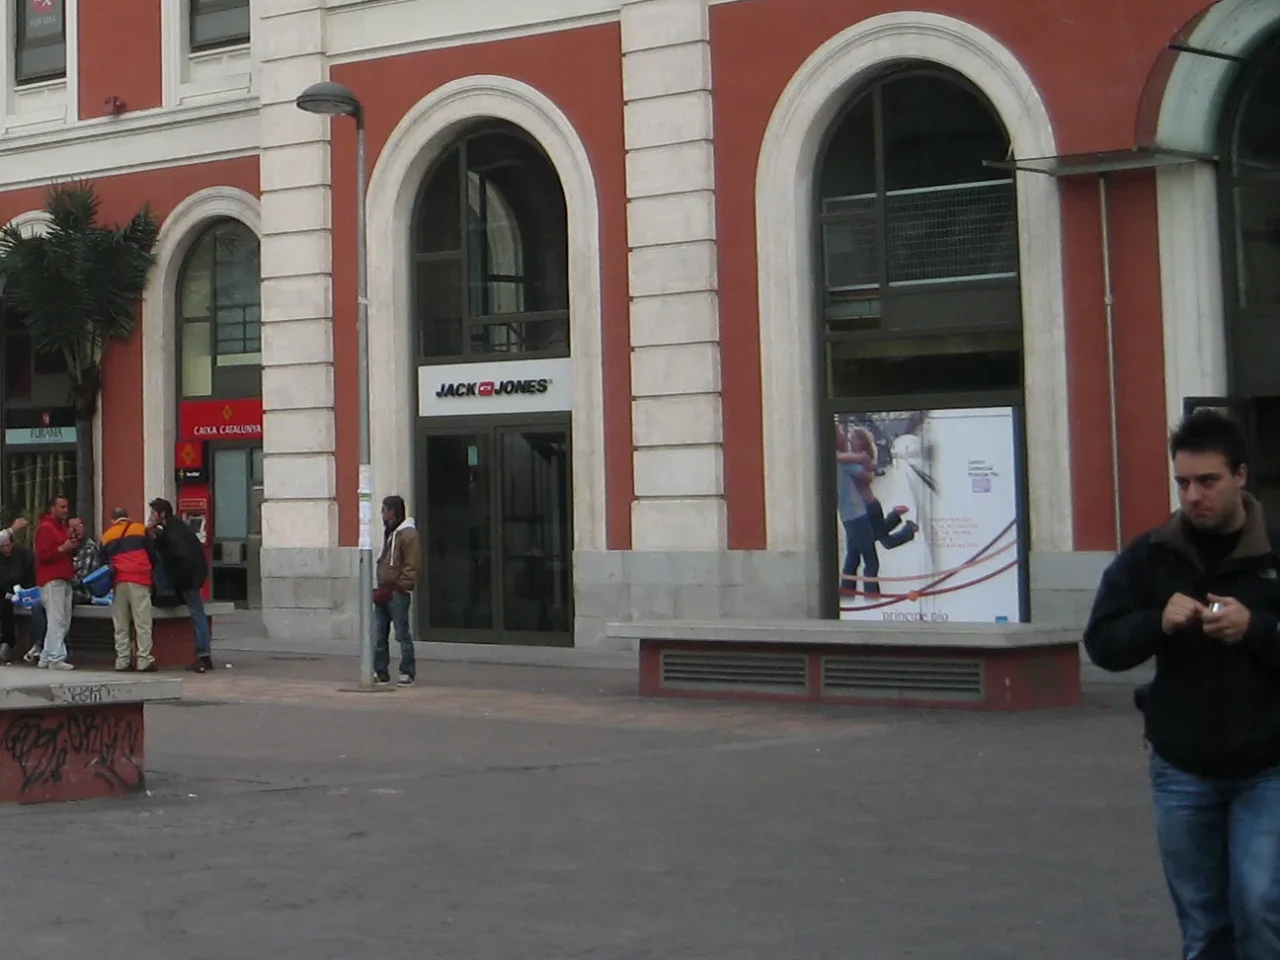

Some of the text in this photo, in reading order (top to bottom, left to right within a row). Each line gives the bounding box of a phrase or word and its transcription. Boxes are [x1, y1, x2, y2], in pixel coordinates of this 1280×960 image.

[435, 378, 549, 398] JACK JONES
[30, 428, 64, 439] FURAMA
[193, 426, 218, 436] CAIXA
